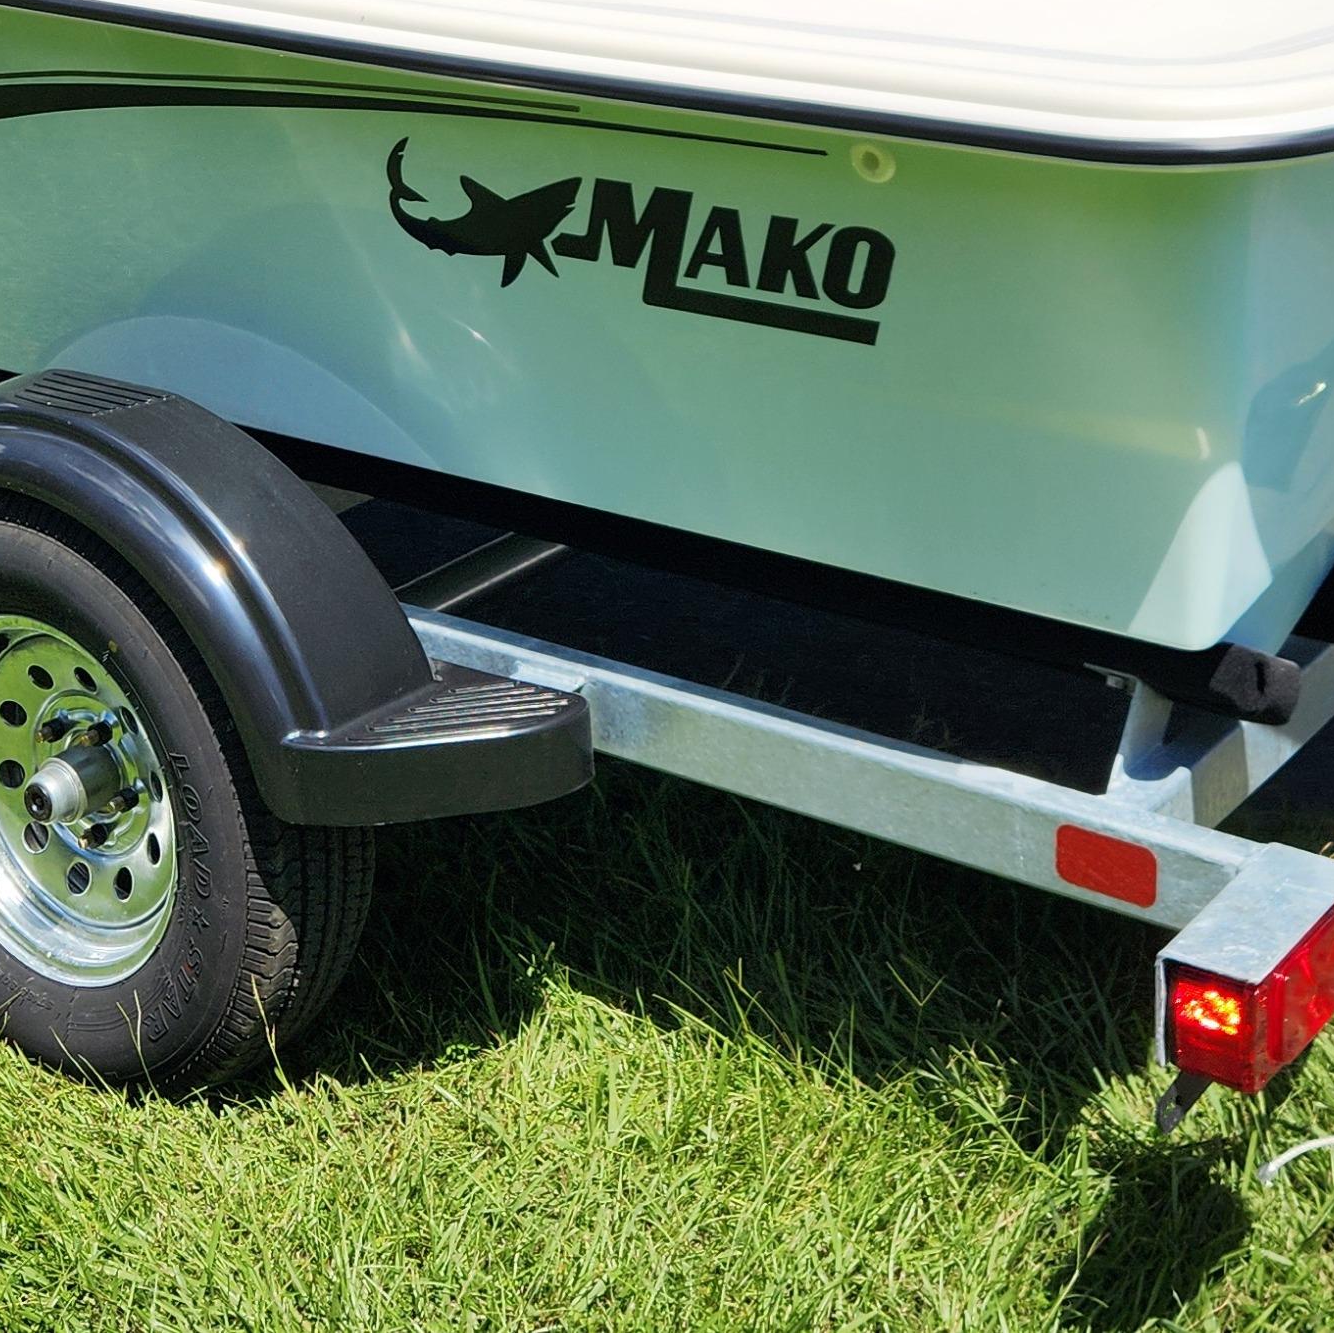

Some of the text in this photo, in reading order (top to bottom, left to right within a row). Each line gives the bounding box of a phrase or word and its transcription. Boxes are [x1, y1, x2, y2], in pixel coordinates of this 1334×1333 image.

[551, 177, 896, 345] MAKO
[144, 751, 212, 1043] LOAD STAR
